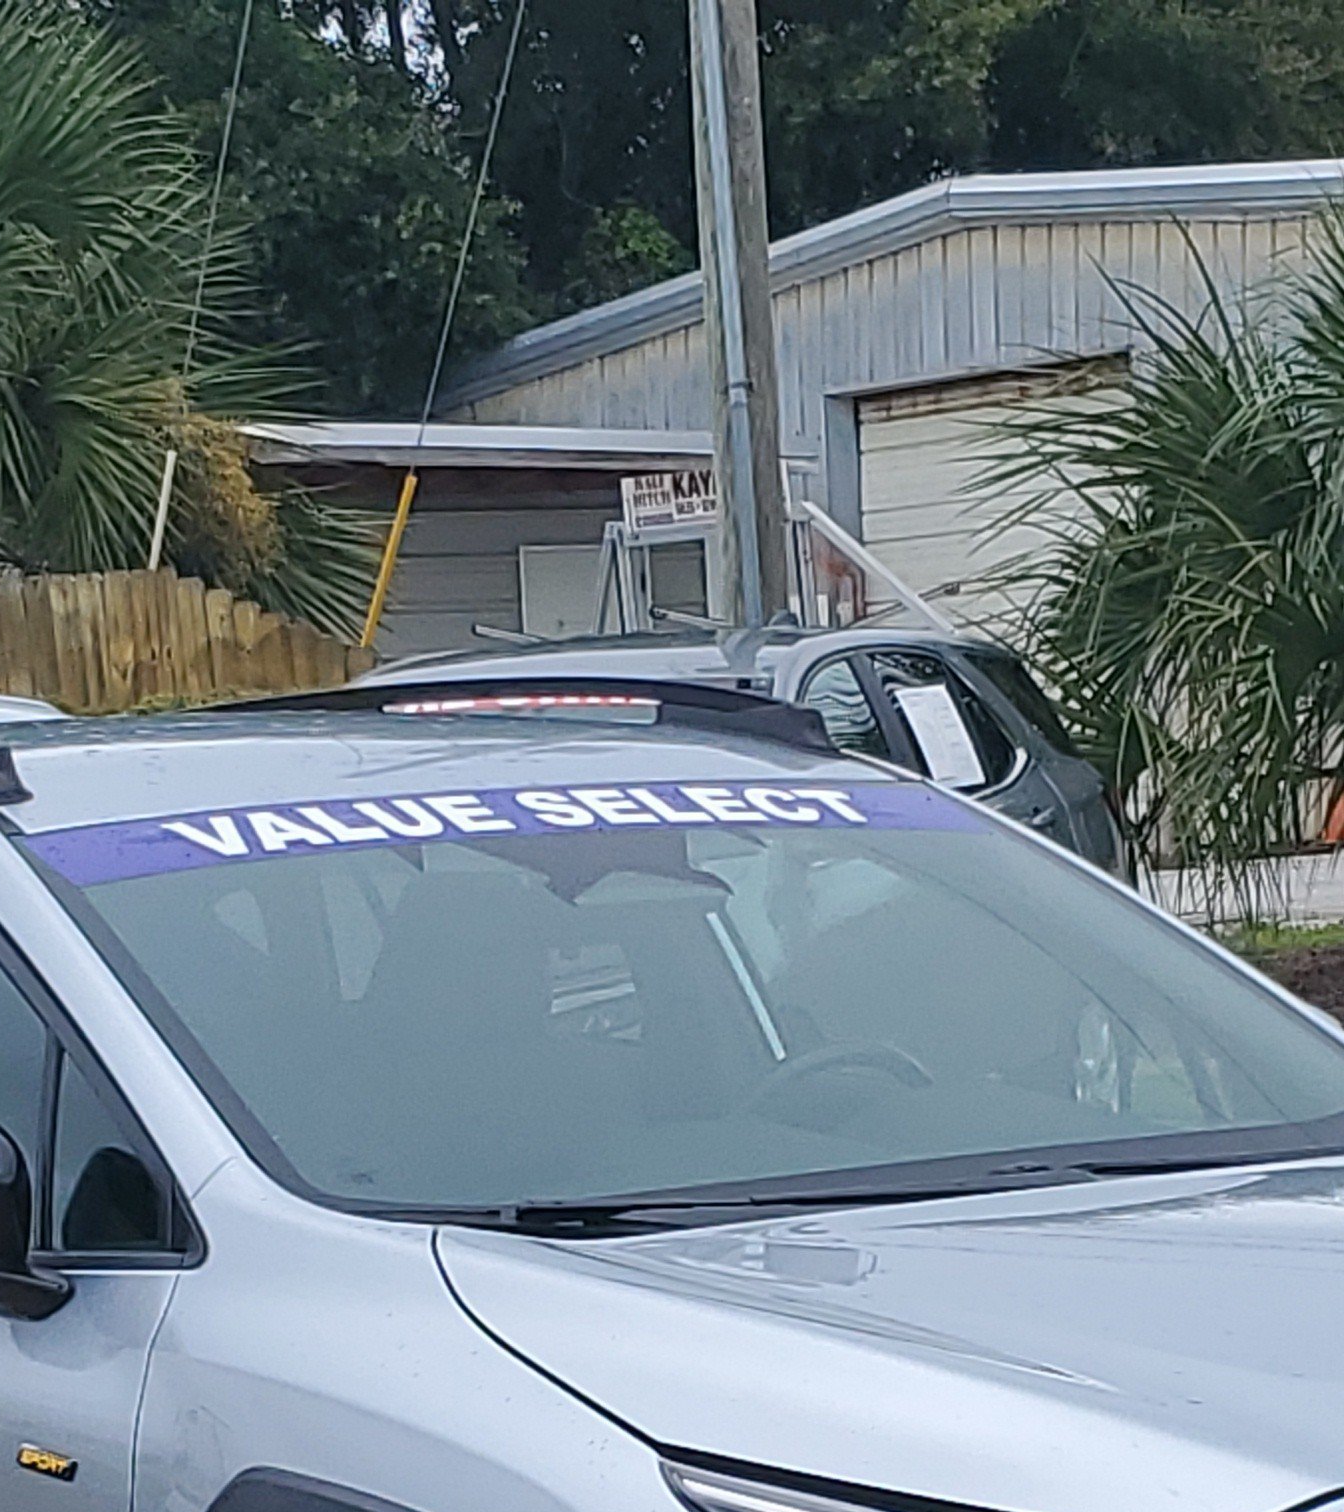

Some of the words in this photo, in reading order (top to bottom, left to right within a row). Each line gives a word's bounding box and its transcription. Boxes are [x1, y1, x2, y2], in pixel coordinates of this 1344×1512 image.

[673, 469, 717, 500] KAY
[160, 794, 517, 858] VALUE
[515, 787, 868, 827] SELECT
